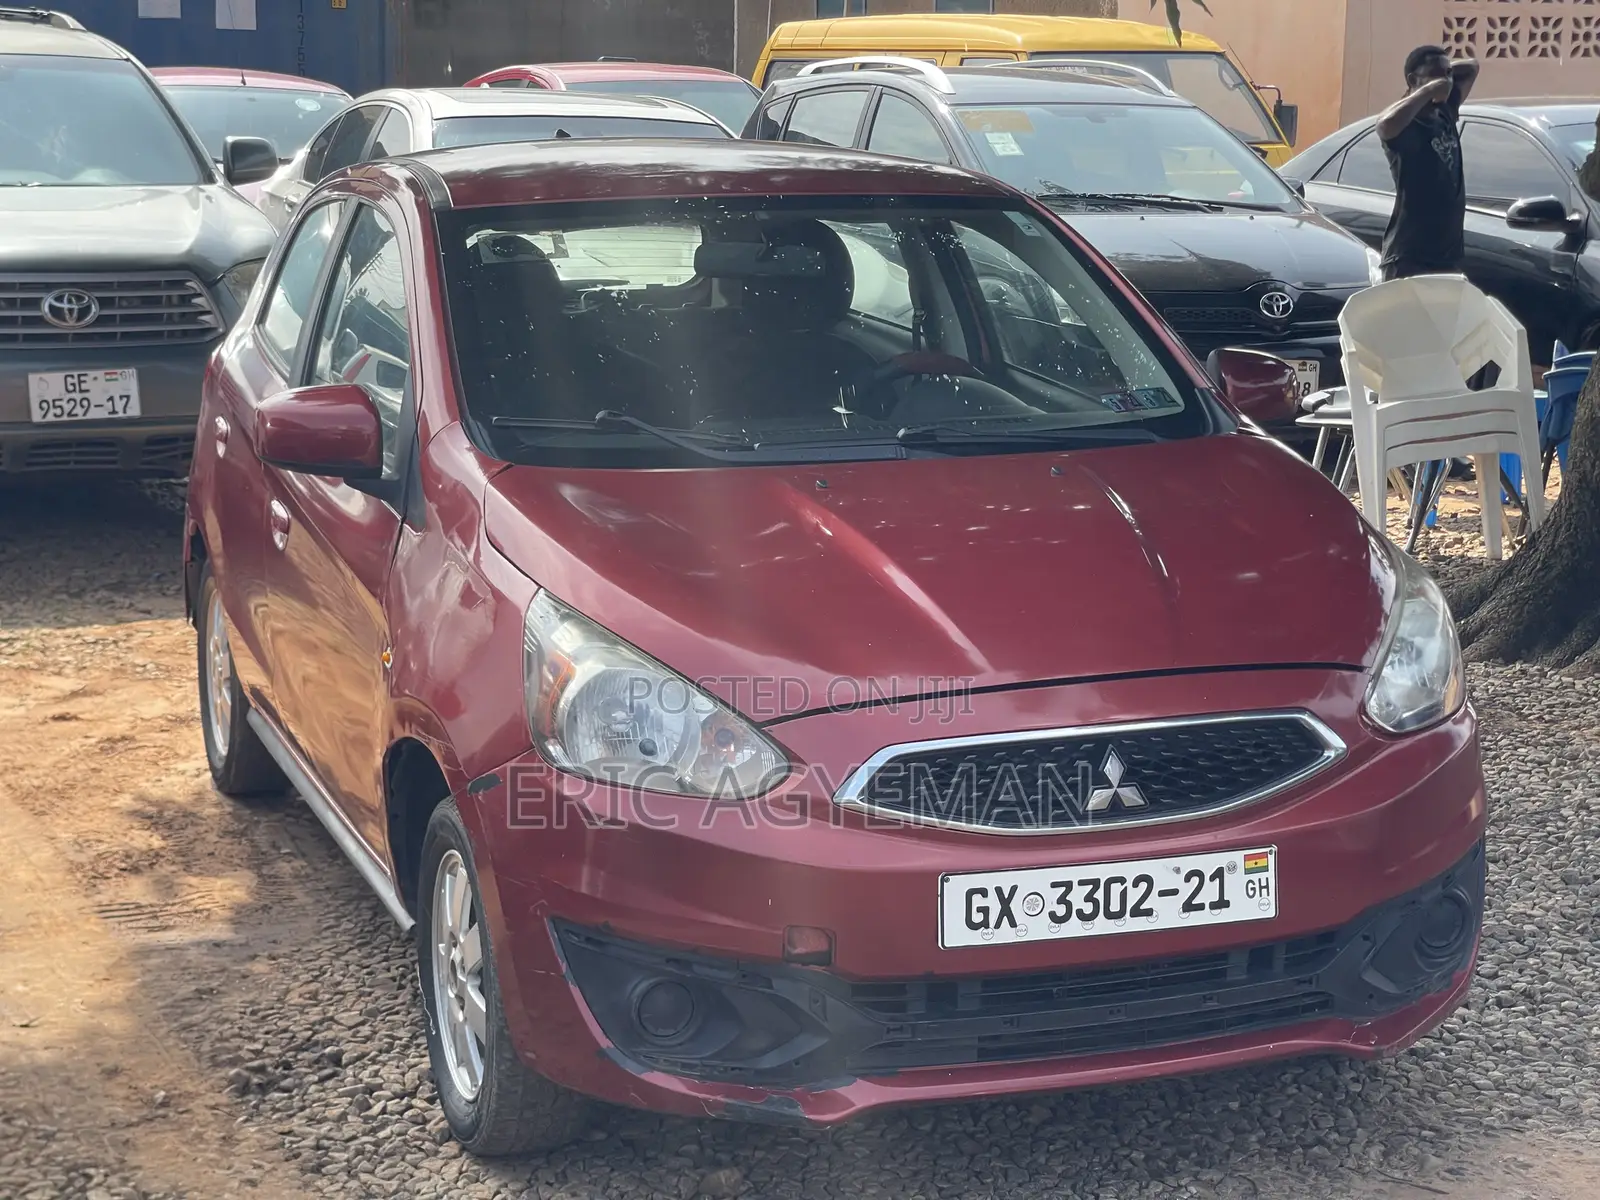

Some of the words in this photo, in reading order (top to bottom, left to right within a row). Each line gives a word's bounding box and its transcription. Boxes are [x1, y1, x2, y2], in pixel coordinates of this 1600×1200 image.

[64, 373, 91, 394] GE
[38, 394, 131, 419] 9529-17
[964, 884, 1019, 931] GX
[1048, 865, 1231, 924] 3302-21
[1245, 877, 1270, 899] GH
